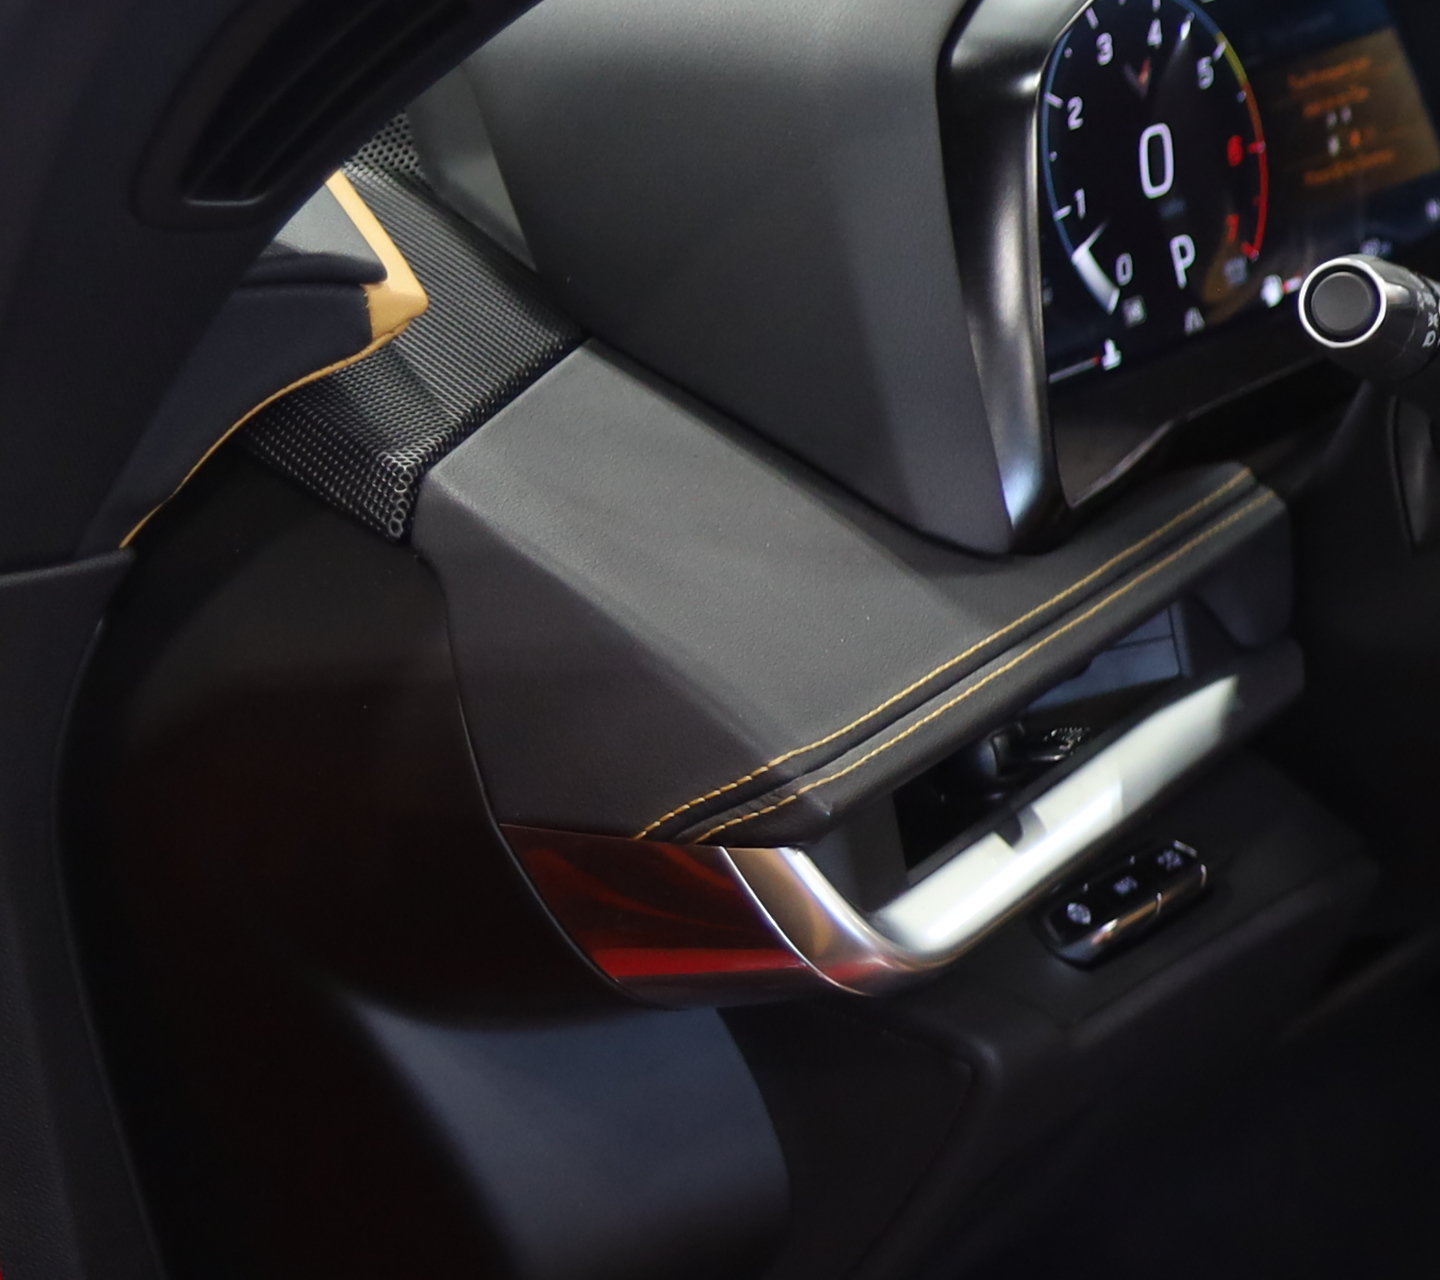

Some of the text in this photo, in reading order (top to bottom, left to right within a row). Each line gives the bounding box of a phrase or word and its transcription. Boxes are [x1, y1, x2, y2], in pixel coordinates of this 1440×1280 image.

[1096, 32, 1113, 66] 3
[1147, 19, 1163, 48] 4
[1197, 56, 1214, 89] 5
[1067, 96, 1083, 130] 2
[1139, 122, 1174, 199] 0
[1074, 188, 1086, 219] 1
[1115, 253, 1133, 286] 0
[1169, 234, 1196, 289] P
